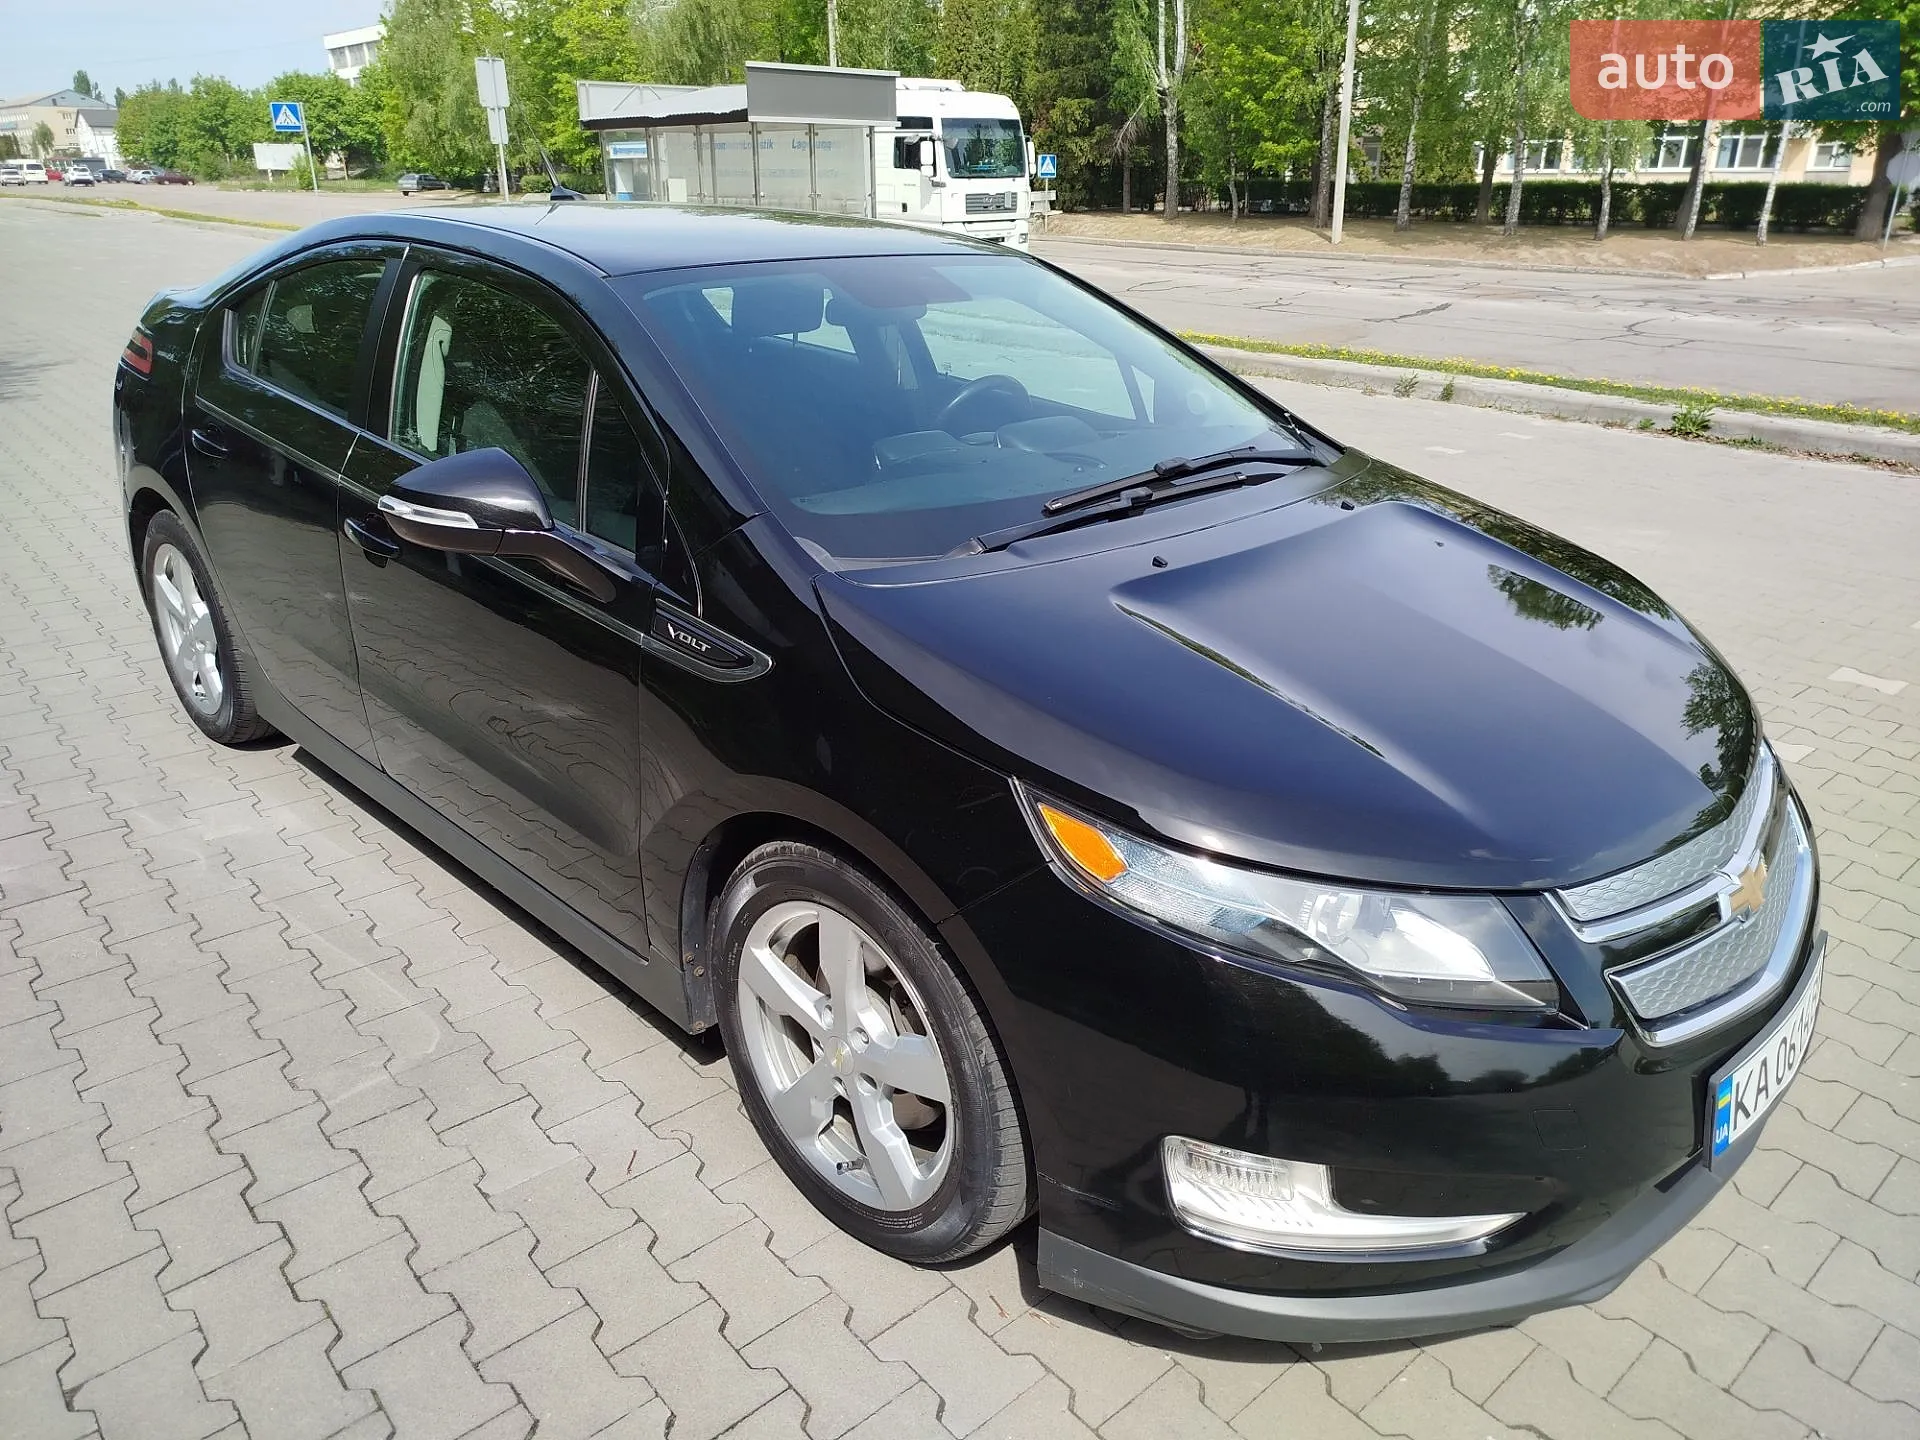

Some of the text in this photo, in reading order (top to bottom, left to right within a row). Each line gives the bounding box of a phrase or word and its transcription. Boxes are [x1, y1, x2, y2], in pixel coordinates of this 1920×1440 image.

[743, 138, 774, 150] Lostik
[791, 137, 832, 151] Lagung
[667, 622, 712, 653] VOLT
[1715, 1122, 1729, 1144] UA
